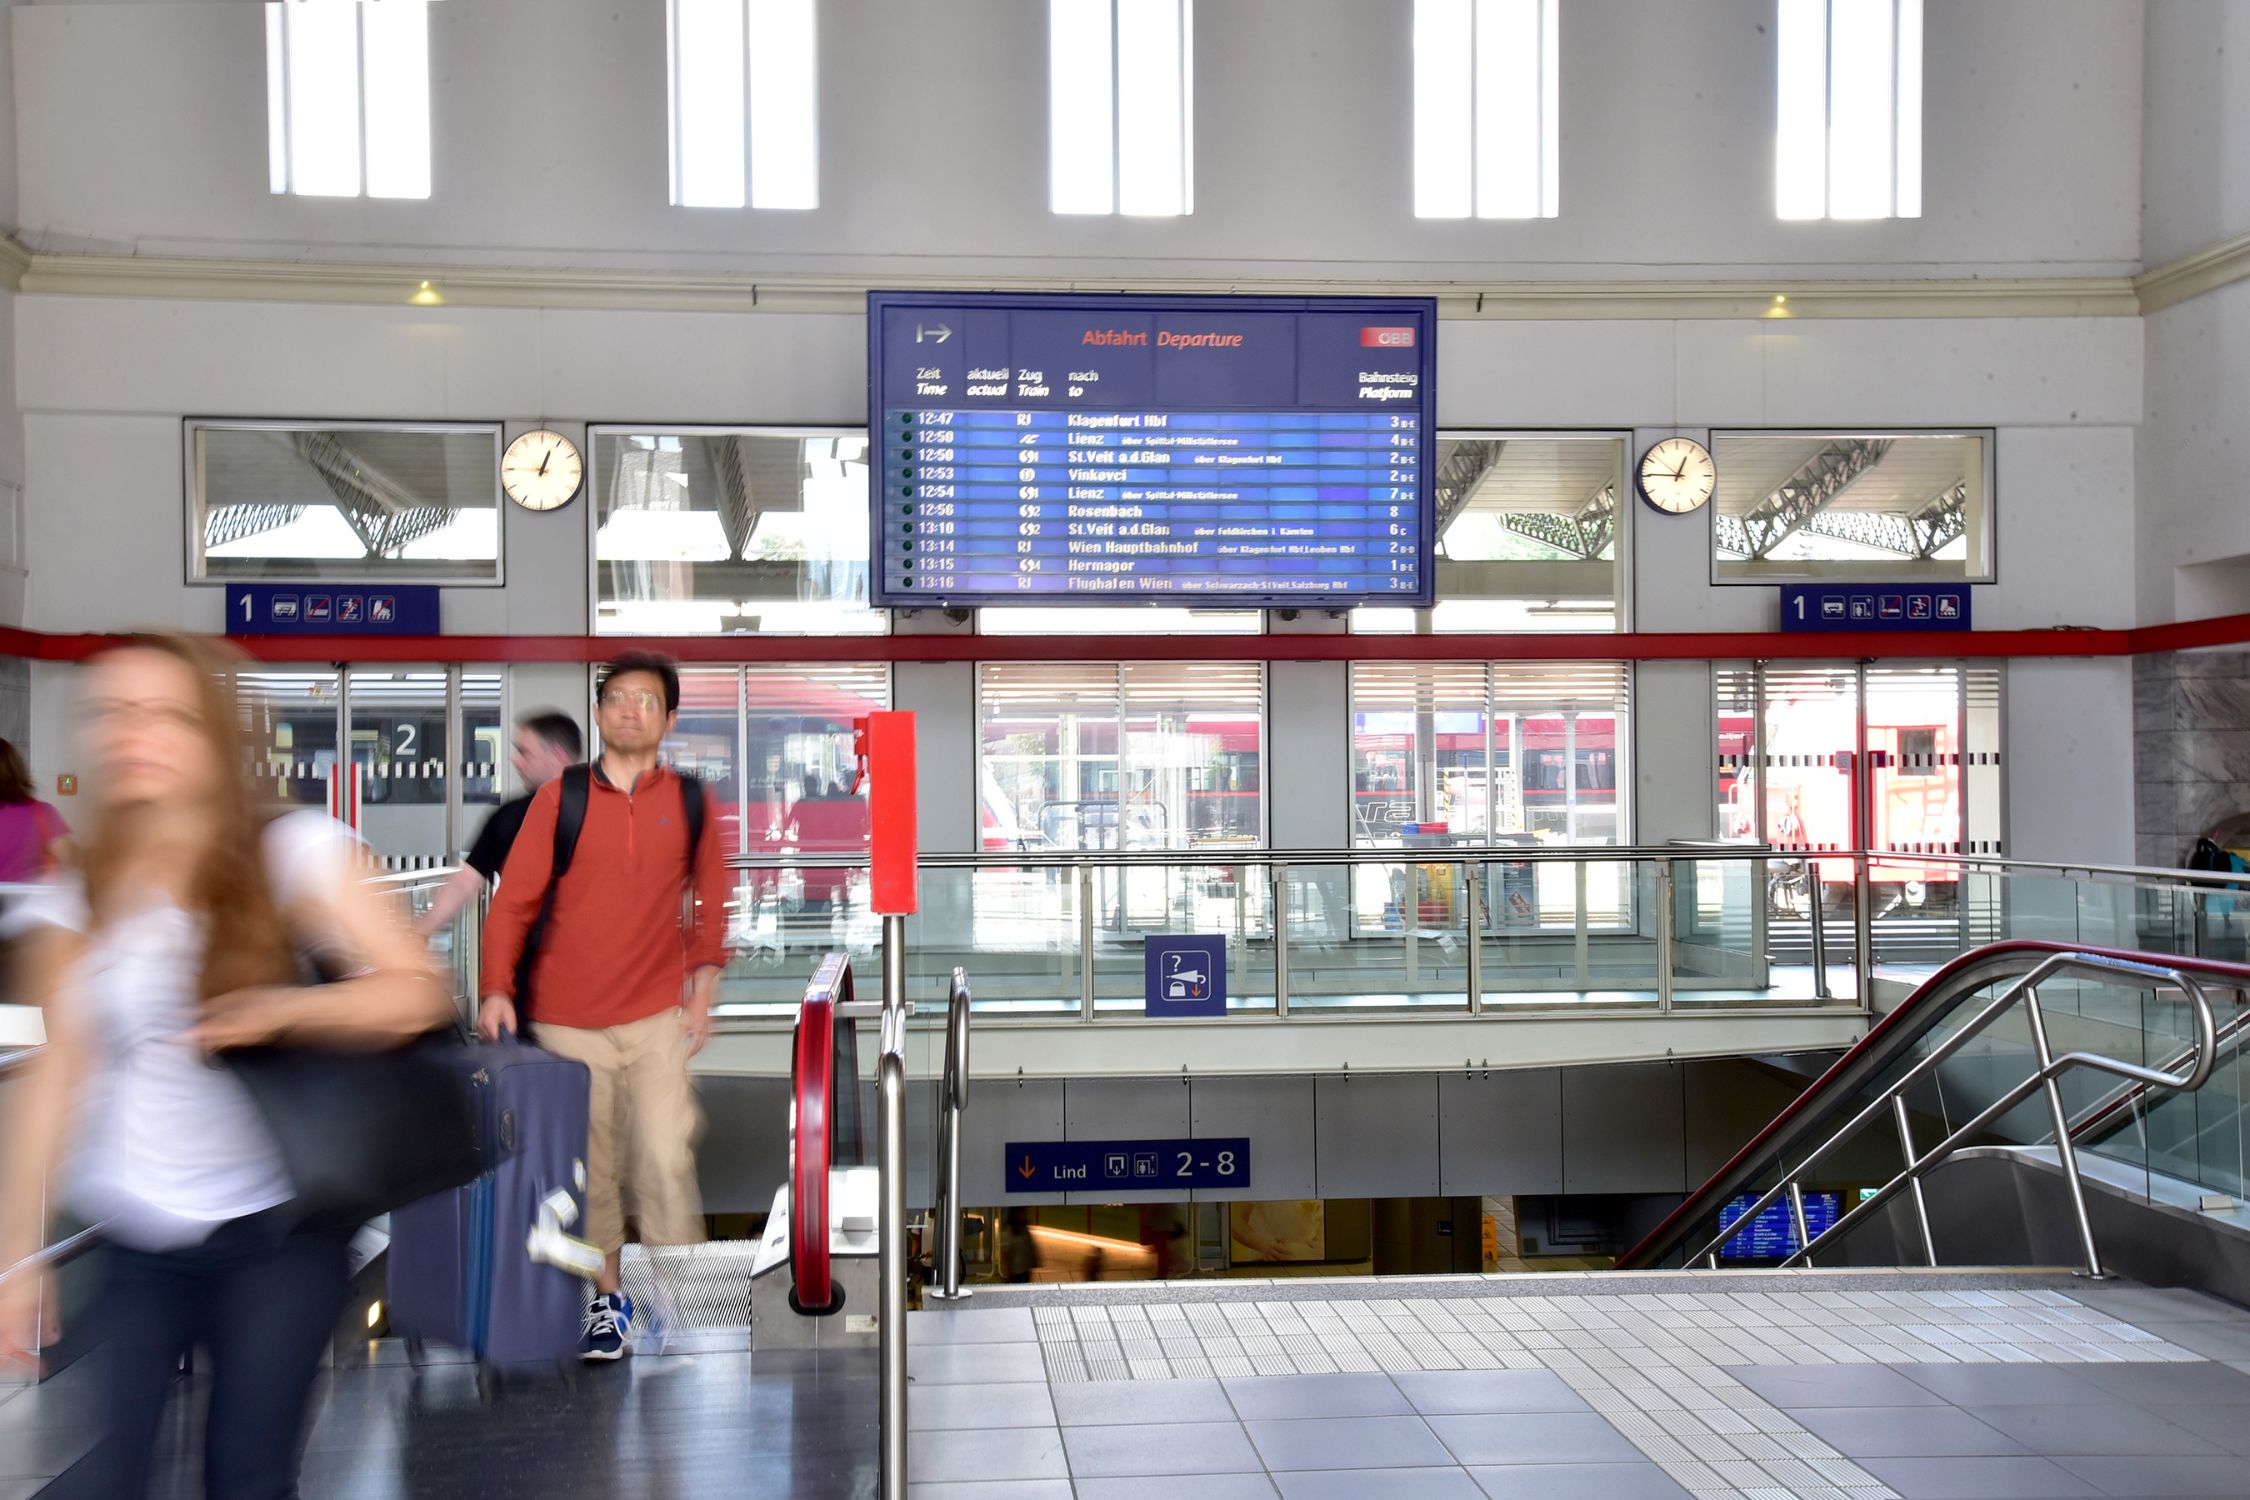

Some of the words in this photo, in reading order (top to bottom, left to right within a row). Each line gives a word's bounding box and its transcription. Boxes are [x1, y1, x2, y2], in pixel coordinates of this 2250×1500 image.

[1082, 330, 1148, 346] Abfahrt
[1157, 331, 1244, 350] Departure
[917, 367, 941, 380] Zeit
[967, 367, 1009, 380] aktuell
[1018, 369, 1043, 383] Zug
[1068, 370, 1099, 382] nach
[1358, 372, 1418, 386] Bahnsteig
[917, 383, 948, 396] Time
[967, 383, 1008, 396] actual
[1018, 383, 1050, 396] Train
[1068, 385, 1083, 397] to
[1358, 386, 1413, 401] Platform
[918, 412, 953, 425] 12:47
[1017, 413, 1031, 426] RJ
[1068, 415, 1140, 428] Klagenfurt
[1144, 415, 1167, 427] Hbf
[1390, 416, 1399, 428] 3
[918, 430, 954, 443] 12:50
[1068, 433, 1104, 446] Lienz
[1390, 434, 1399, 446] 4
[918, 448, 954, 461] 12:50
[1068, 450, 1114, 463] St.Veit
[1119, 451, 1170, 464] a.d.Glan
[1390, 452, 1399, 464] 2
[918, 467, 954, 480] 12:53
[1068, 468, 1127, 481] Vinkovci
[1390, 470, 1399, 481] 2
[918, 485, 954, 498] 12:54
[1068, 487, 1104, 500] Lienz
[1390, 487, 1399, 500] 7
[1068, 505, 1143, 518] Rosenbach
[1390, 505, 1399, 517] 8
[919, 522, 954, 535] 13:10
[1068, 523, 1114, 536] St.Veit
[1119, 524, 1170, 537] a.d.Glan
[1390, 523, 1398, 535] 6
[919, 539, 954, 552] 13:14
[1017, 541, 1032, 553] RJ
[1068, 542, 1101, 554] Wien
[1106, 541, 1198, 555] Hauptbahnhof
[1390, 541, 1398, 553] 2
[919, 558, 954, 571] 13:15
[1068, 559, 1135, 573] Hermagor
[1391, 559, 1397, 571] 1
[1017, 577, 1031, 589] RJ
[1068, 577, 1135, 590] Flughafen
[1139, 578, 1172, 590] Wien
[1390, 577, 1398, 589] 3
[240, 594, 252, 622] 1
[1793, 595, 1804, 619] 1
[395, 724, 416, 755] 2
[1054, 1164, 1087, 1179] Lind
